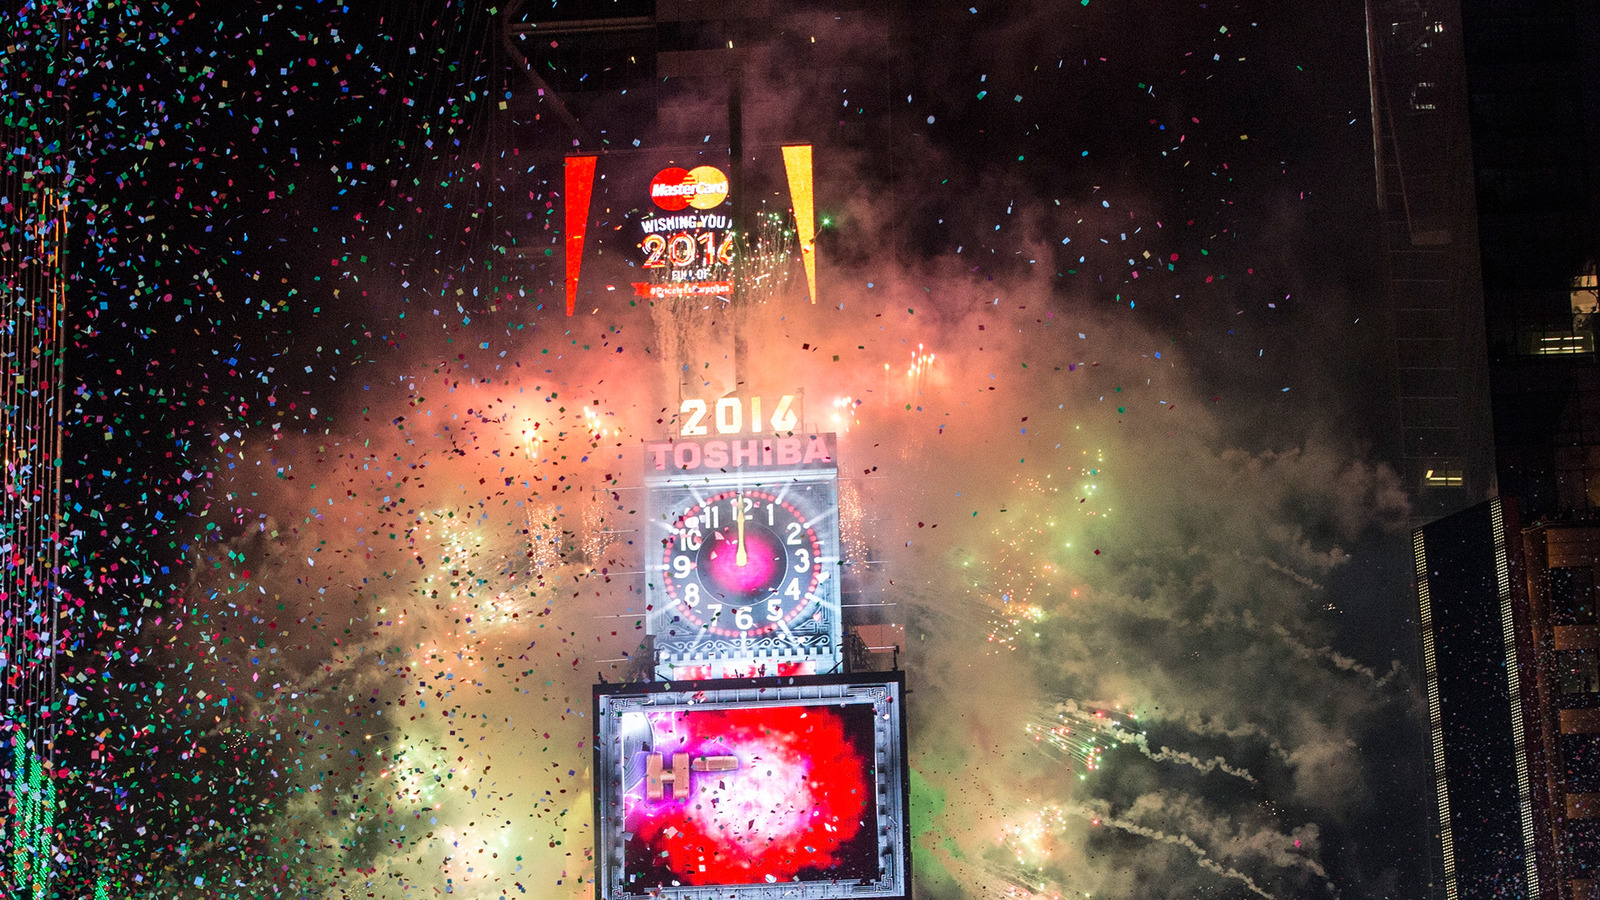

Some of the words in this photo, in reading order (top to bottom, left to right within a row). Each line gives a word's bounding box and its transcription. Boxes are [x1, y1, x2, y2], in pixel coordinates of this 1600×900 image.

[652, 182, 728, 197] MasterCard
[641, 216, 697, 233] WISHING
[700, 215, 726, 229] YOU
[642, 231, 733, 268] 2016
[695, 269, 710, 280] OF
[680, 395, 798, 436] 2016
[648, 437, 831, 470] TOSHIBA
[703, 506, 719, 529] 11
[730, 498, 753, 521] 12
[767, 504, 774, 526] 1
[680, 529, 702, 551] 10
[787, 522, 802, 545] 2
[673, 555, 691, 578] 9
[794, 549, 810, 573] 3
[684, 583, 700, 607] 8
[785, 578, 800, 600] 4
[707, 604, 722, 627] 7
[735, 606, 754, 630] 6
[766, 600, 783, 621] 5
